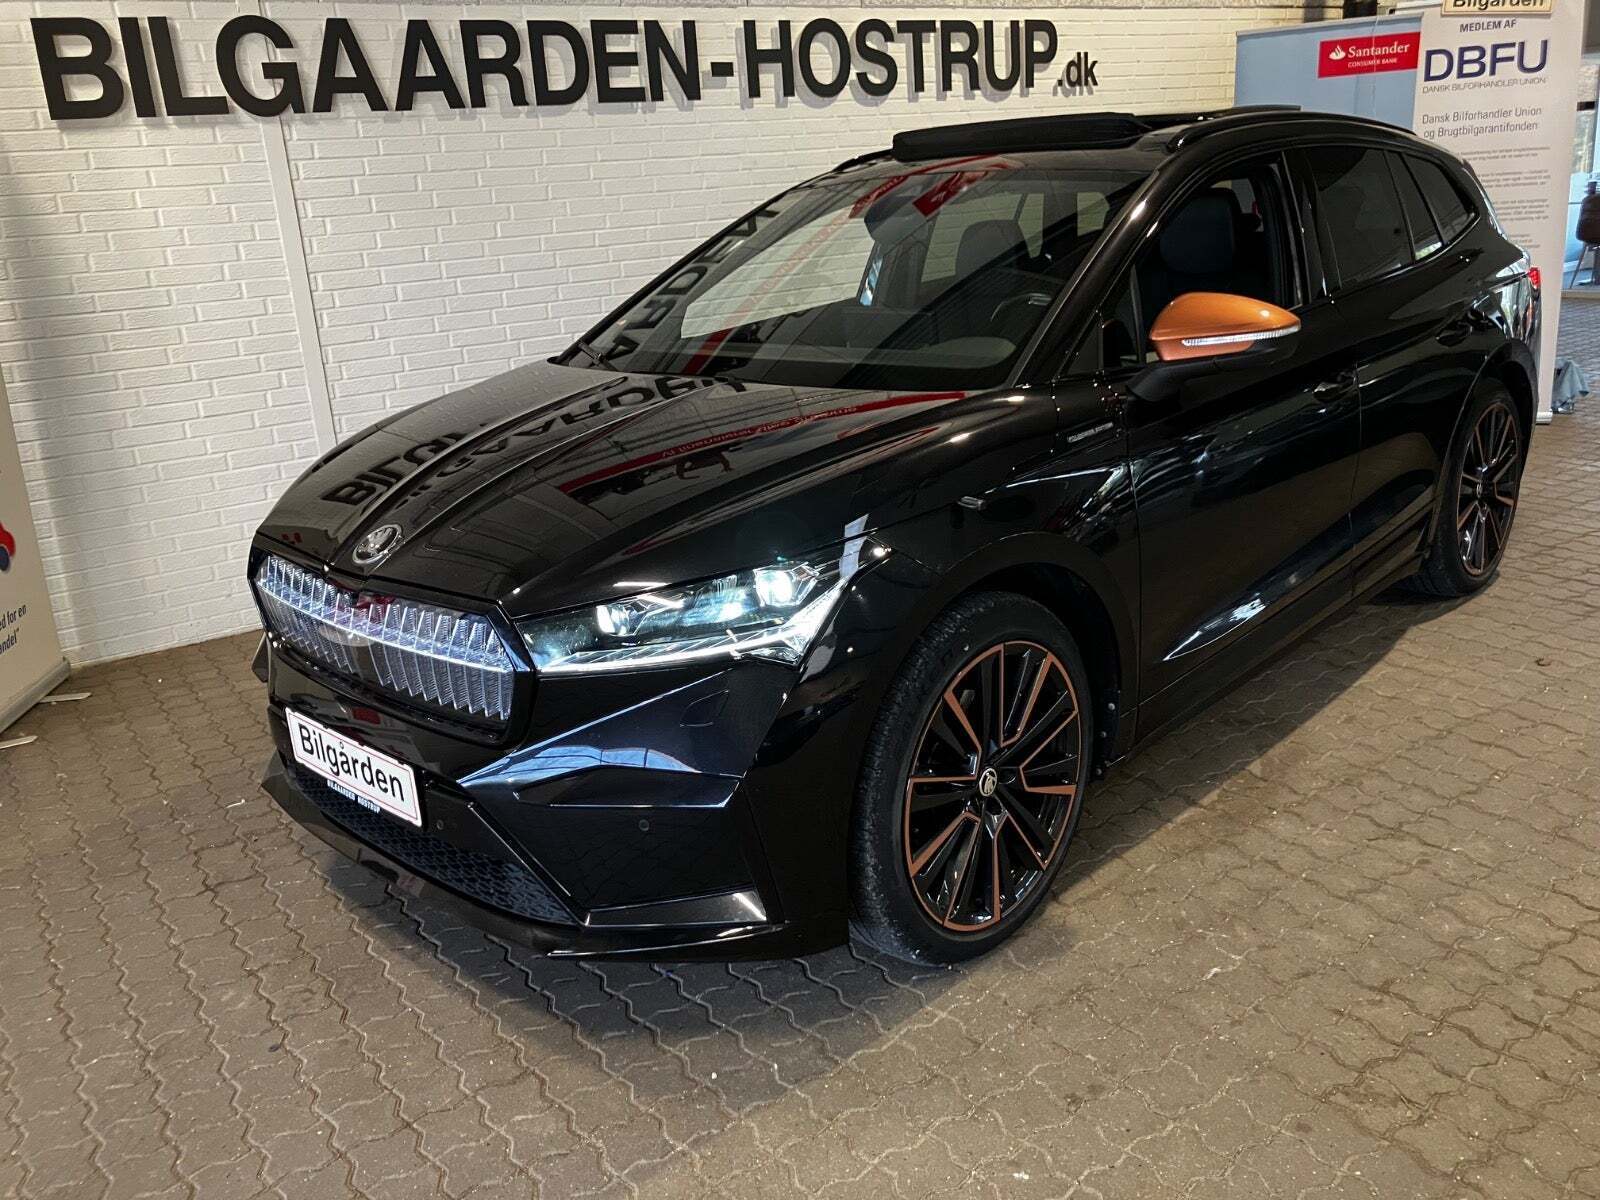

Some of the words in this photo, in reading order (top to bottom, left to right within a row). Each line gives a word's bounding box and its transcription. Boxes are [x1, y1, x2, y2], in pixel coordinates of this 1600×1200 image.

[1459, 20, 1501, 33] MEDLEM
[1503, 19, 1517, 29] AF
[1347, 41, 1410, 58] Santander
[1347, 59, 1380, 68] CONSUMER
[1381, 57, 1398, 65] BANK
[1423, 39, 1548, 82] DBFU
[1422, 84, 1451, 94] DANSK
[1451, 79, 1519, 92] BILFORHANDLER
[1519, 77, 1546, 86] UNION
[1422, 113, 1450, 125] Dansk
[1452, 109, 1513, 122] Bilforhandler
[1514, 106, 1542, 117] Union
[1423, 130, 1435, 139] og
[1437, 121, 1538, 138] Brugtbilgarantifonden
[7, 610, 17, 626] for
[18, 604, 27, 618] en
[298, 722, 405, 803] Bilgården
